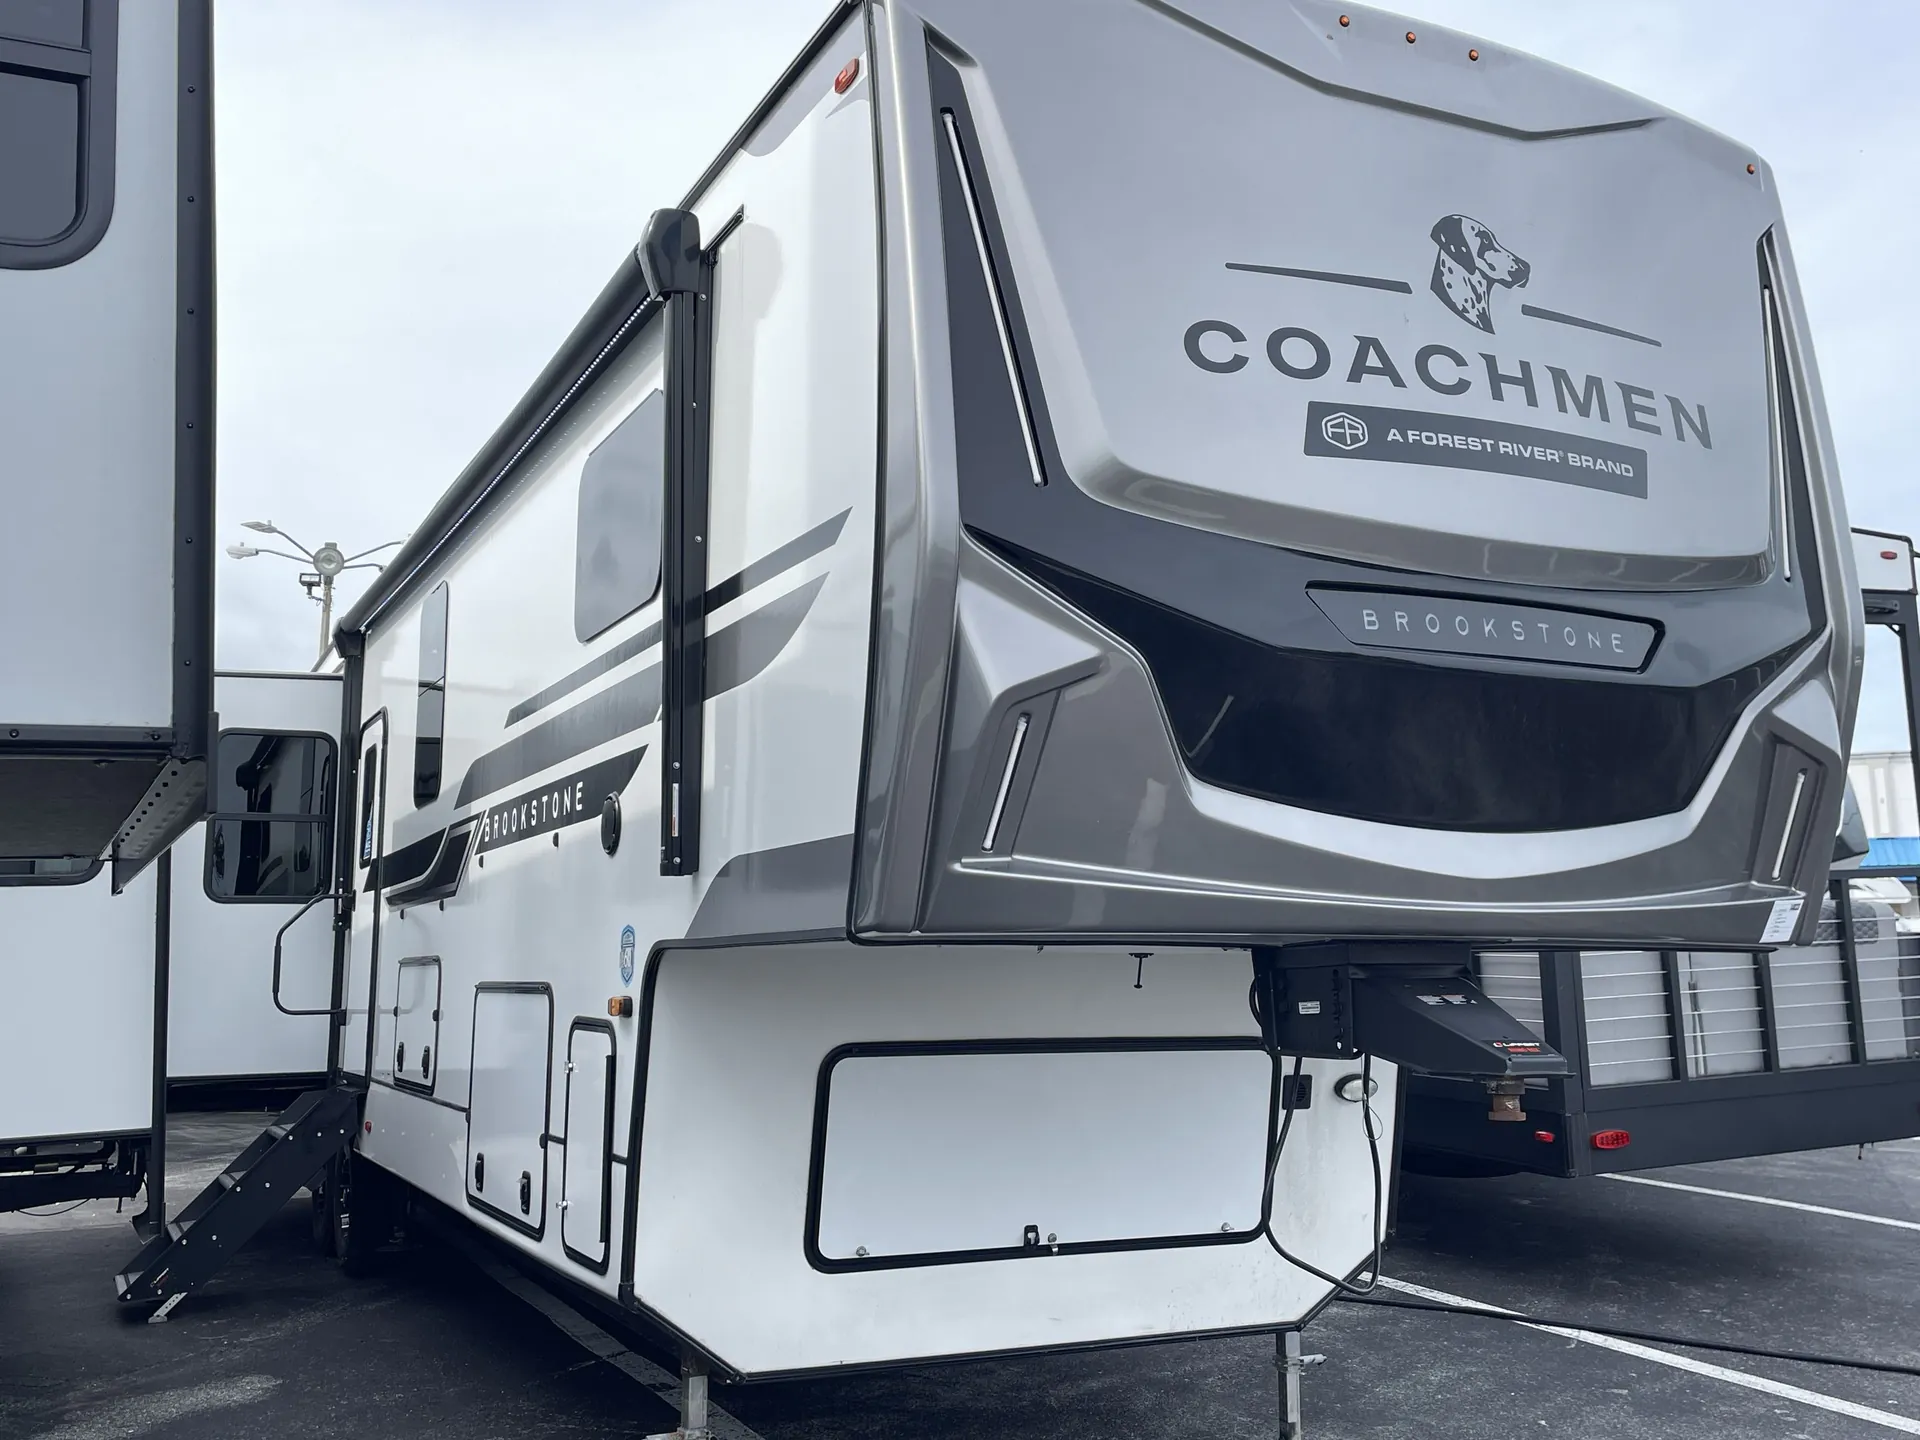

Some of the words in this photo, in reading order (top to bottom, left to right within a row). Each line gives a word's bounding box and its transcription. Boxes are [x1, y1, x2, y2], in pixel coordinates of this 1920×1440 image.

[1184, 320, 1712, 449] COACHMEN
[1387, 428, 1404, 443] A
[1407, 430, 1495, 452] FOREST
[1567, 452, 1634, 477] BRAND
[1362, 609, 1624, 653] BROOKSTONE
[485, 781, 584, 842] BROOKSTONE
